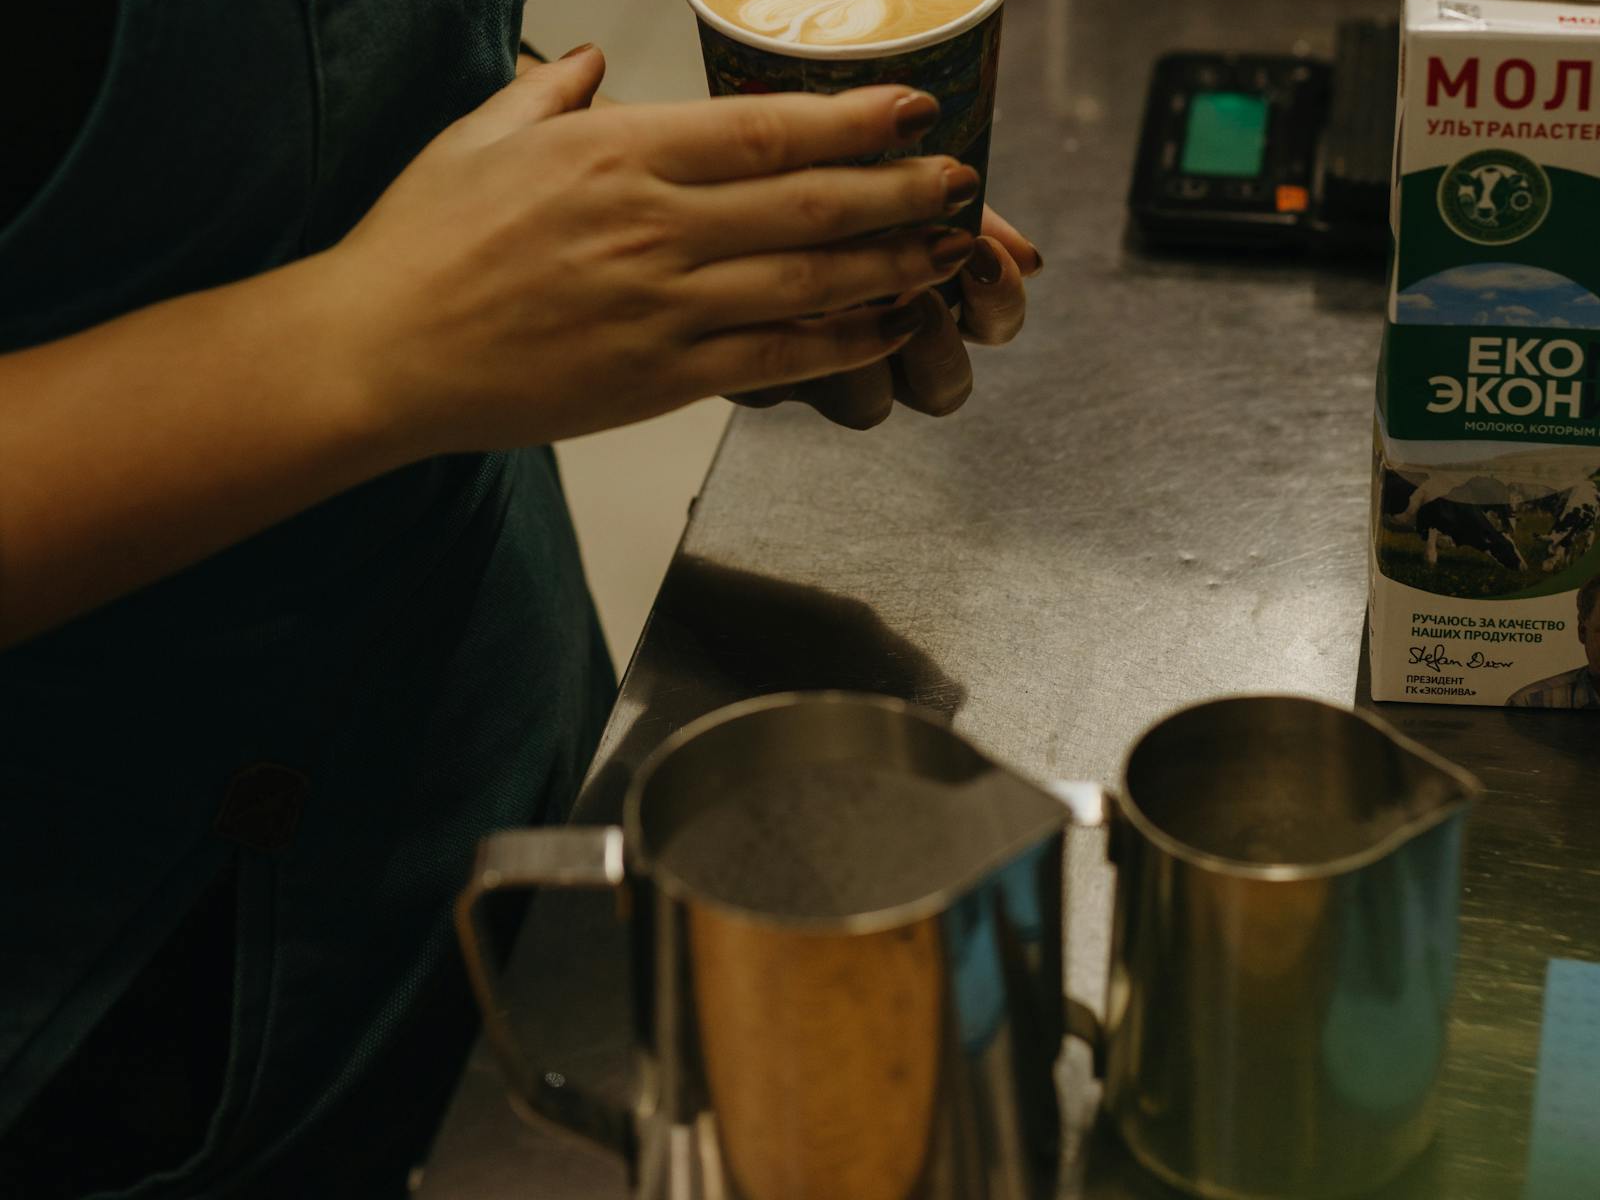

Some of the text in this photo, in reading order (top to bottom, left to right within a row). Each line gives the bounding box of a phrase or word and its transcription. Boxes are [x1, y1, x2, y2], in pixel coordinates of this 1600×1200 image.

[1426, 57, 1593, 111] МОЛ
[1464, 421, 1528, 434] МОЛОКО,
[1529, 424, 1595, 437] КОТОРЫМ
[1412, 613, 1565, 631] РУЧАЮСЬ ЗА КАЧЕСТВО
[1411, 627, 1543, 643] НАШИХ ПРОДУКТОВ
[1406, 675, 1465, 685] ПРЕЗИДЕНТ
[1405, 686, 1477, 696] ГК «ЭКОНИВА»
